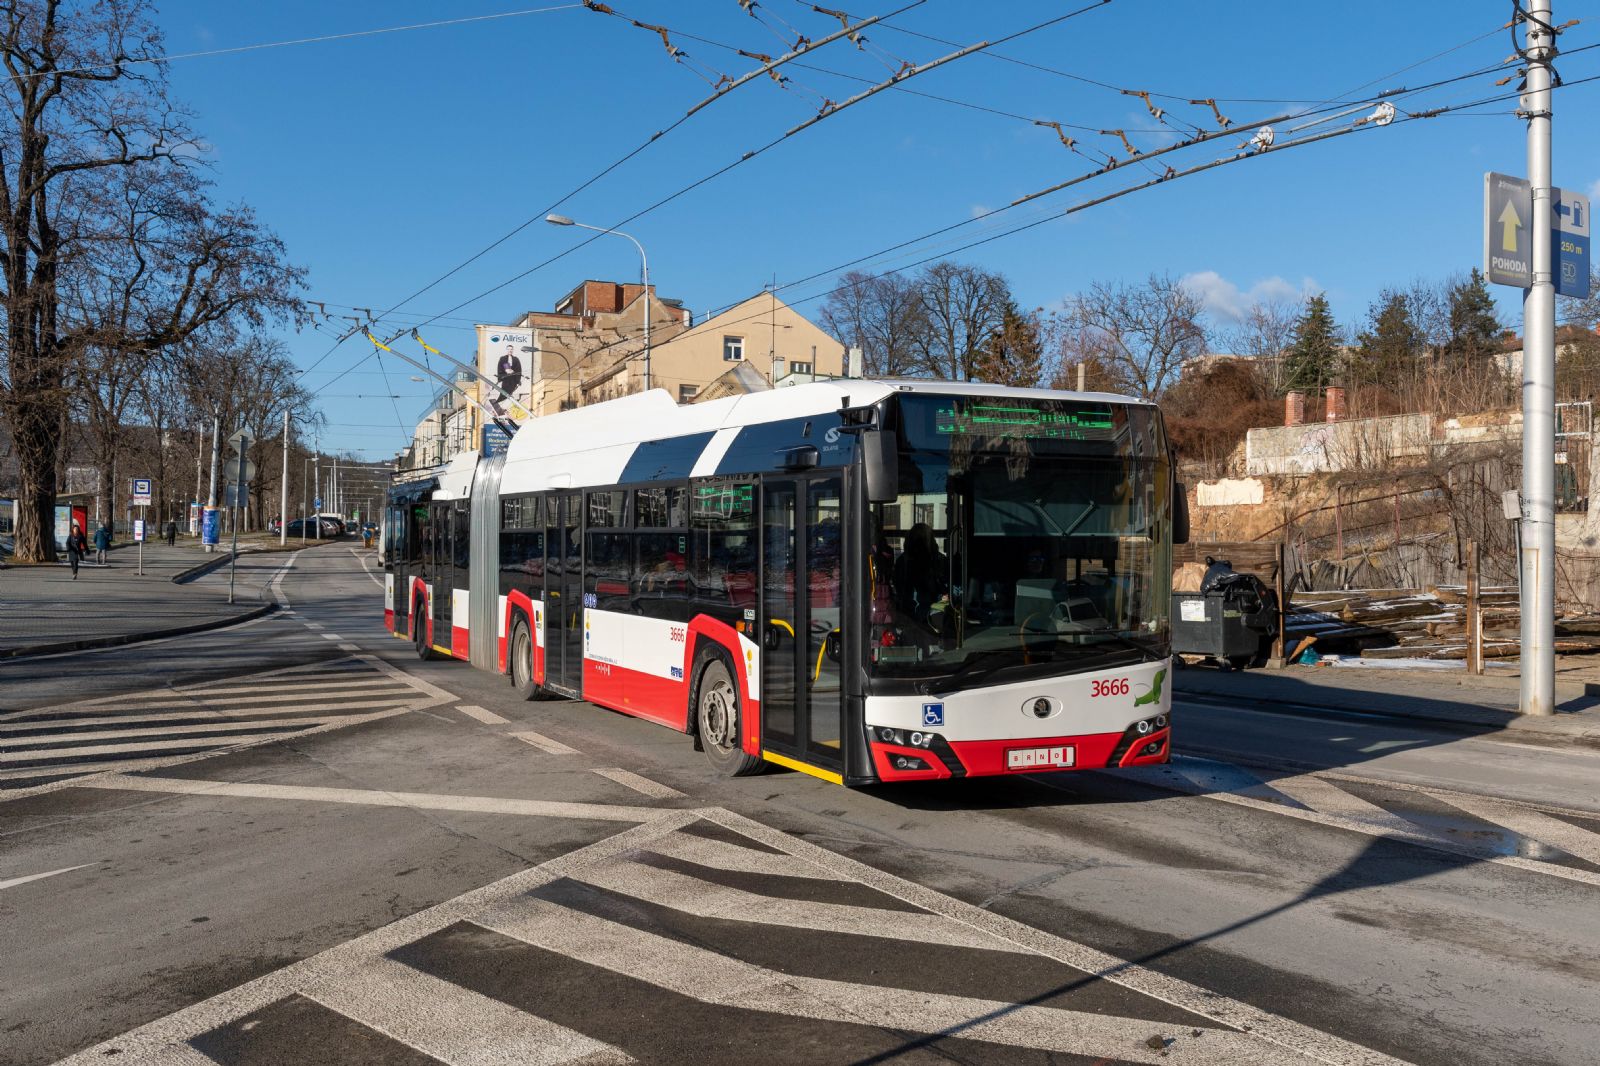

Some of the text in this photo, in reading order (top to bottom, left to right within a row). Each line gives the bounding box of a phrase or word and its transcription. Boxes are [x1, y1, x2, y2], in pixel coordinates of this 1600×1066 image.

[1561, 241, 1574, 253] 250
[1492, 256, 1528, 273] POHODA
[502, 334, 528, 343] Allrisk
[670, 626, 685, 643] 3666
[1091, 677, 1129, 698] 3666
